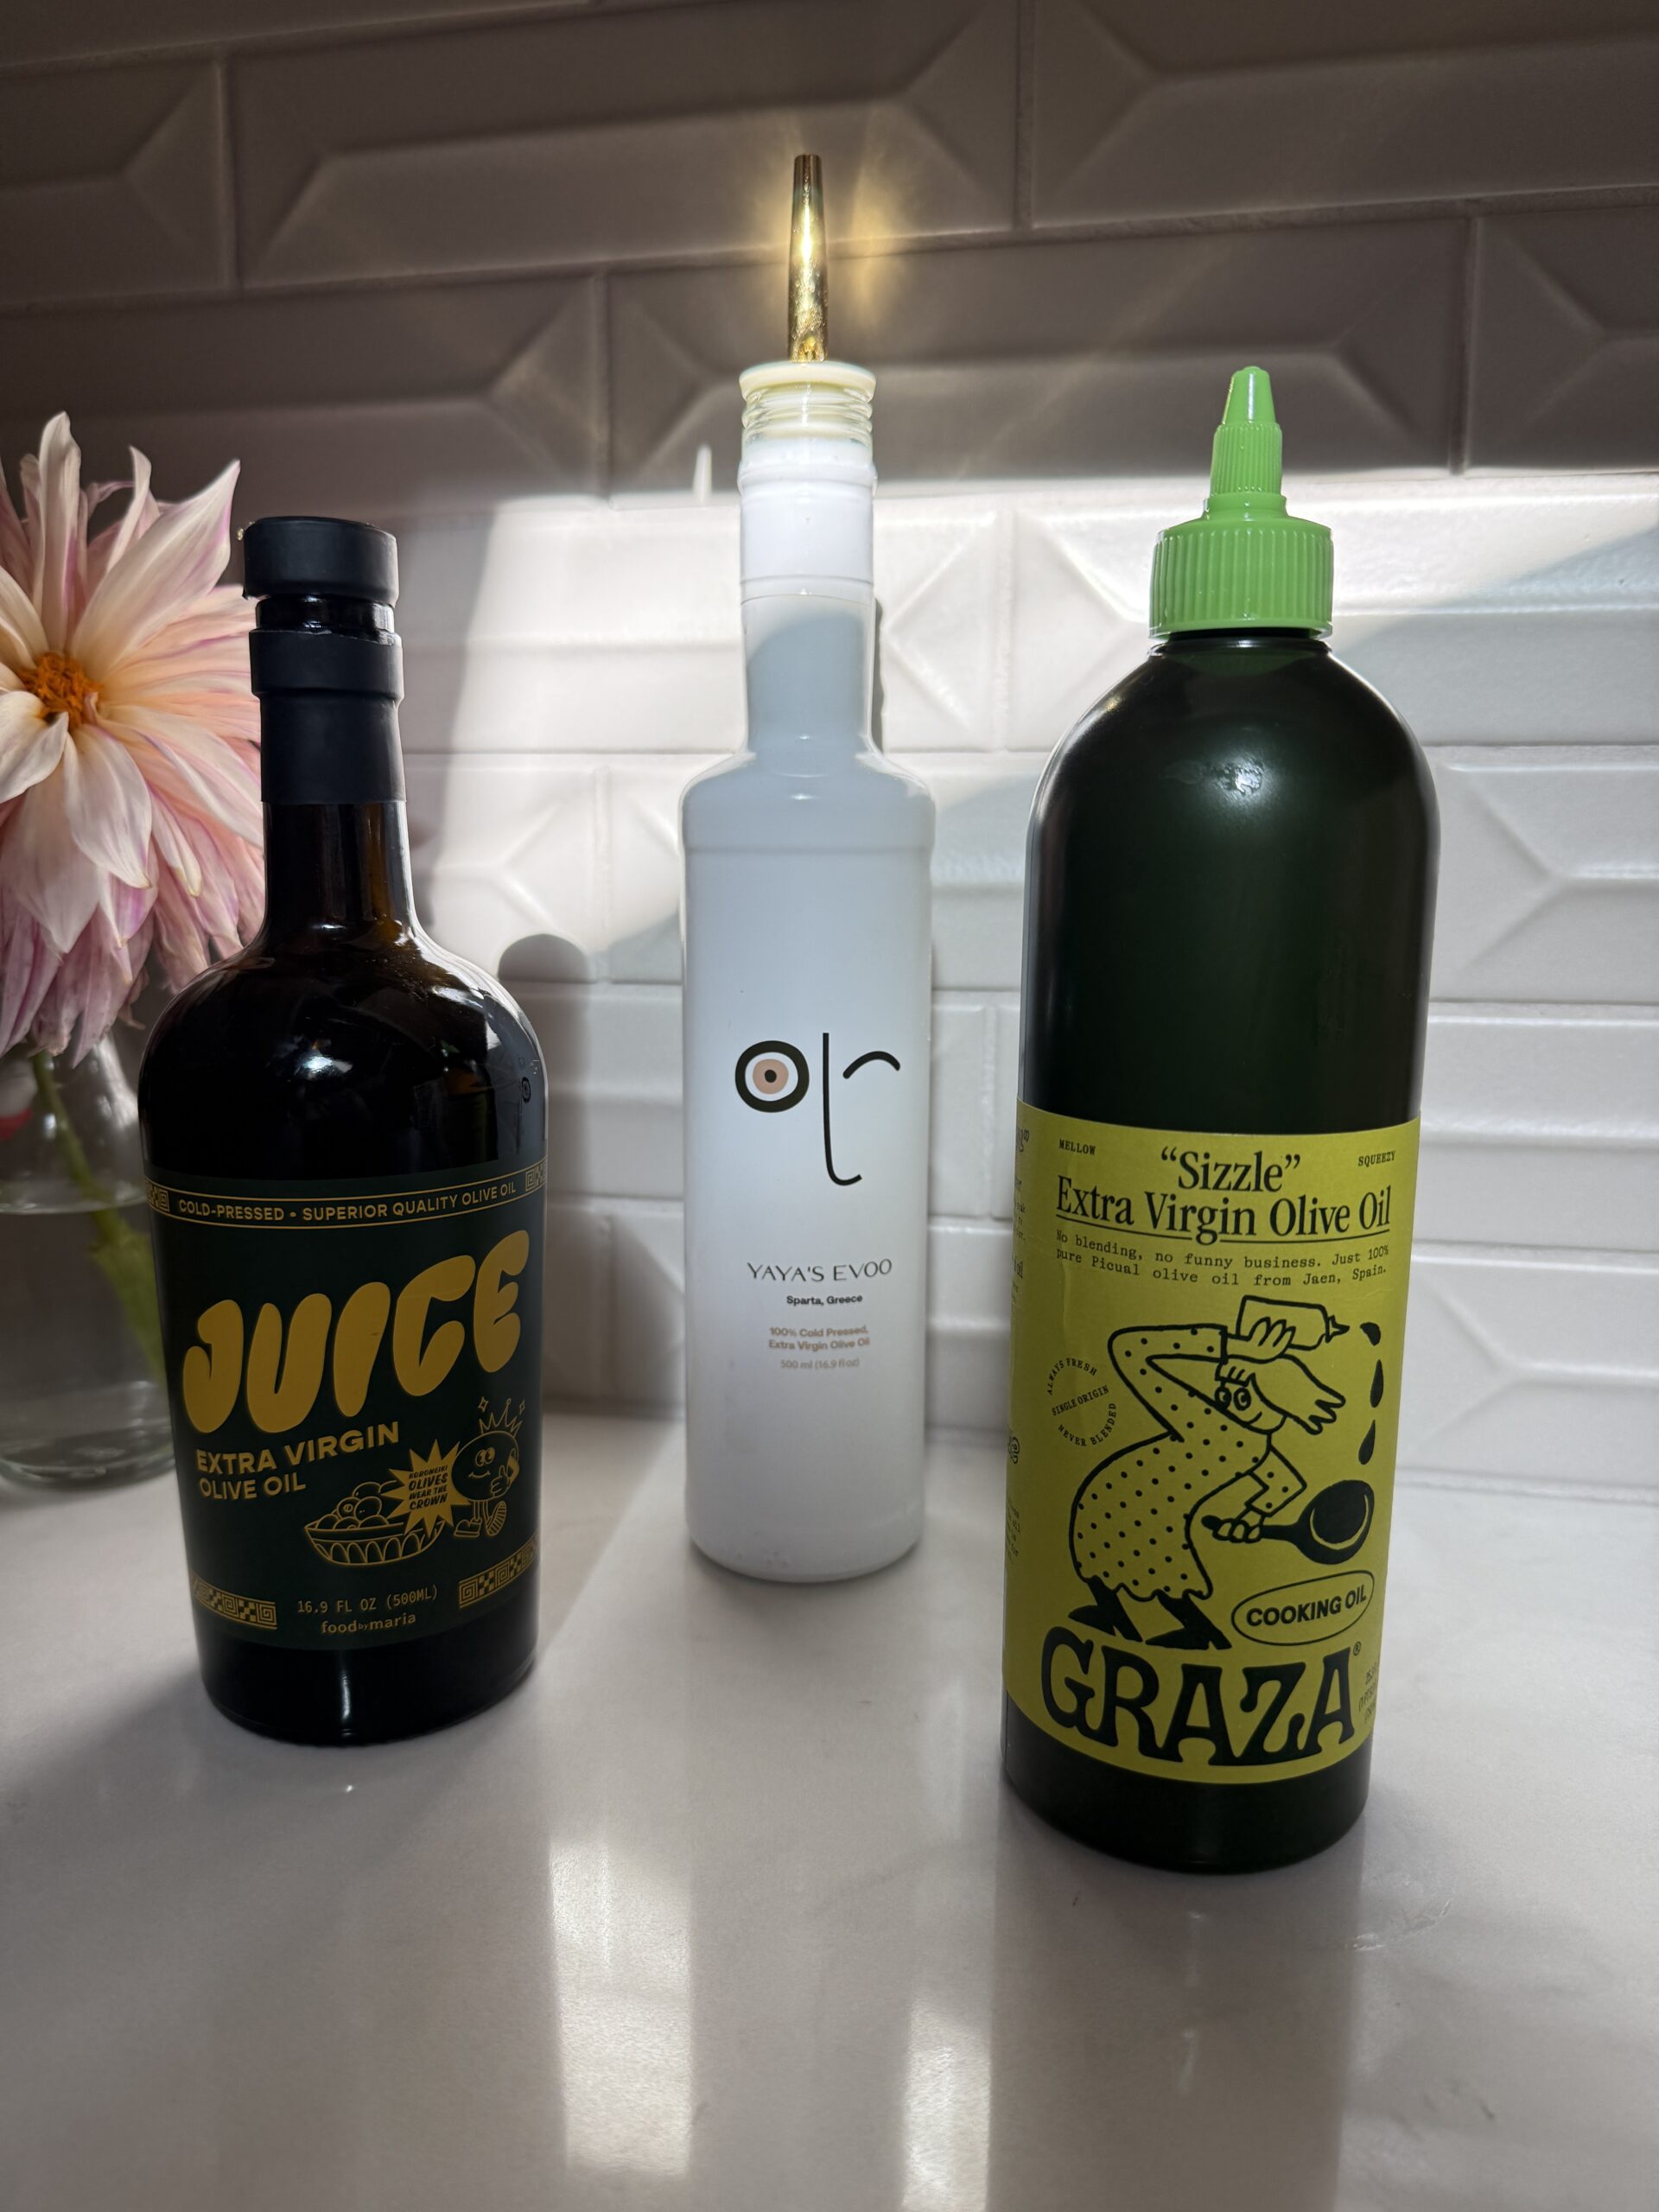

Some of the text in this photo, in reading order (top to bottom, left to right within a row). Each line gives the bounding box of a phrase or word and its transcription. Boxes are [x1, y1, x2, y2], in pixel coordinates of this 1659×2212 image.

[1058, 1139, 1096, 1155] MELLOW
[1357, 1150, 1396, 1167] SQUEEZY
[1160, 1146, 1300, 1192] “Sizzle”
[179, 1181, 517, 1221] COLD-PRESSED SUPERIOR QUALITY OLIVE OIL
[1056, 1174, 1391, 1246] Extra Virgin Olive Oil
[1056, 1230, 1389, 1269] No blending, no funny business. Just 100%
[747, 1259, 892, 1282] YAYA'S EVOO
[1056, 1249, 1387, 1286] pure Picual olive oil from Jaen, Spain.
[786, 1295, 863, 1306] Sparta, Greece
[182, 1230, 530, 1433] JUICE
[768, 1337, 870, 1352] Extra Virgin Olive Oil
[769, 1327, 798, 1337] 100%
[799, 1328, 823, 1338] Cold
[780, 1359, 798, 1370] 500
[800, 1359, 813, 1370] ml
[814, 1359, 836, 1370] (16.9
[1046, 1357, 1097, 1395] ALWAYS FRESH
[1052, 1384, 1109, 1416] SINGLE ORIGIN
[1058, 1402, 1117, 1446] NEVER BLENDED
[195, 1421, 400, 1476] EXTRA VIRGIN
[199, 1471, 307, 1501] OLIVE OIL
[409, 1473, 448, 1491] OLIVES
[410, 1485, 448, 1500] WEAR THE
[410, 1493, 448, 1510] CROWN
[296, 1584, 438, 1614] 16.9 FL OZ (500ML)
[1246, 1584, 1368, 1627] COOKING OIL
